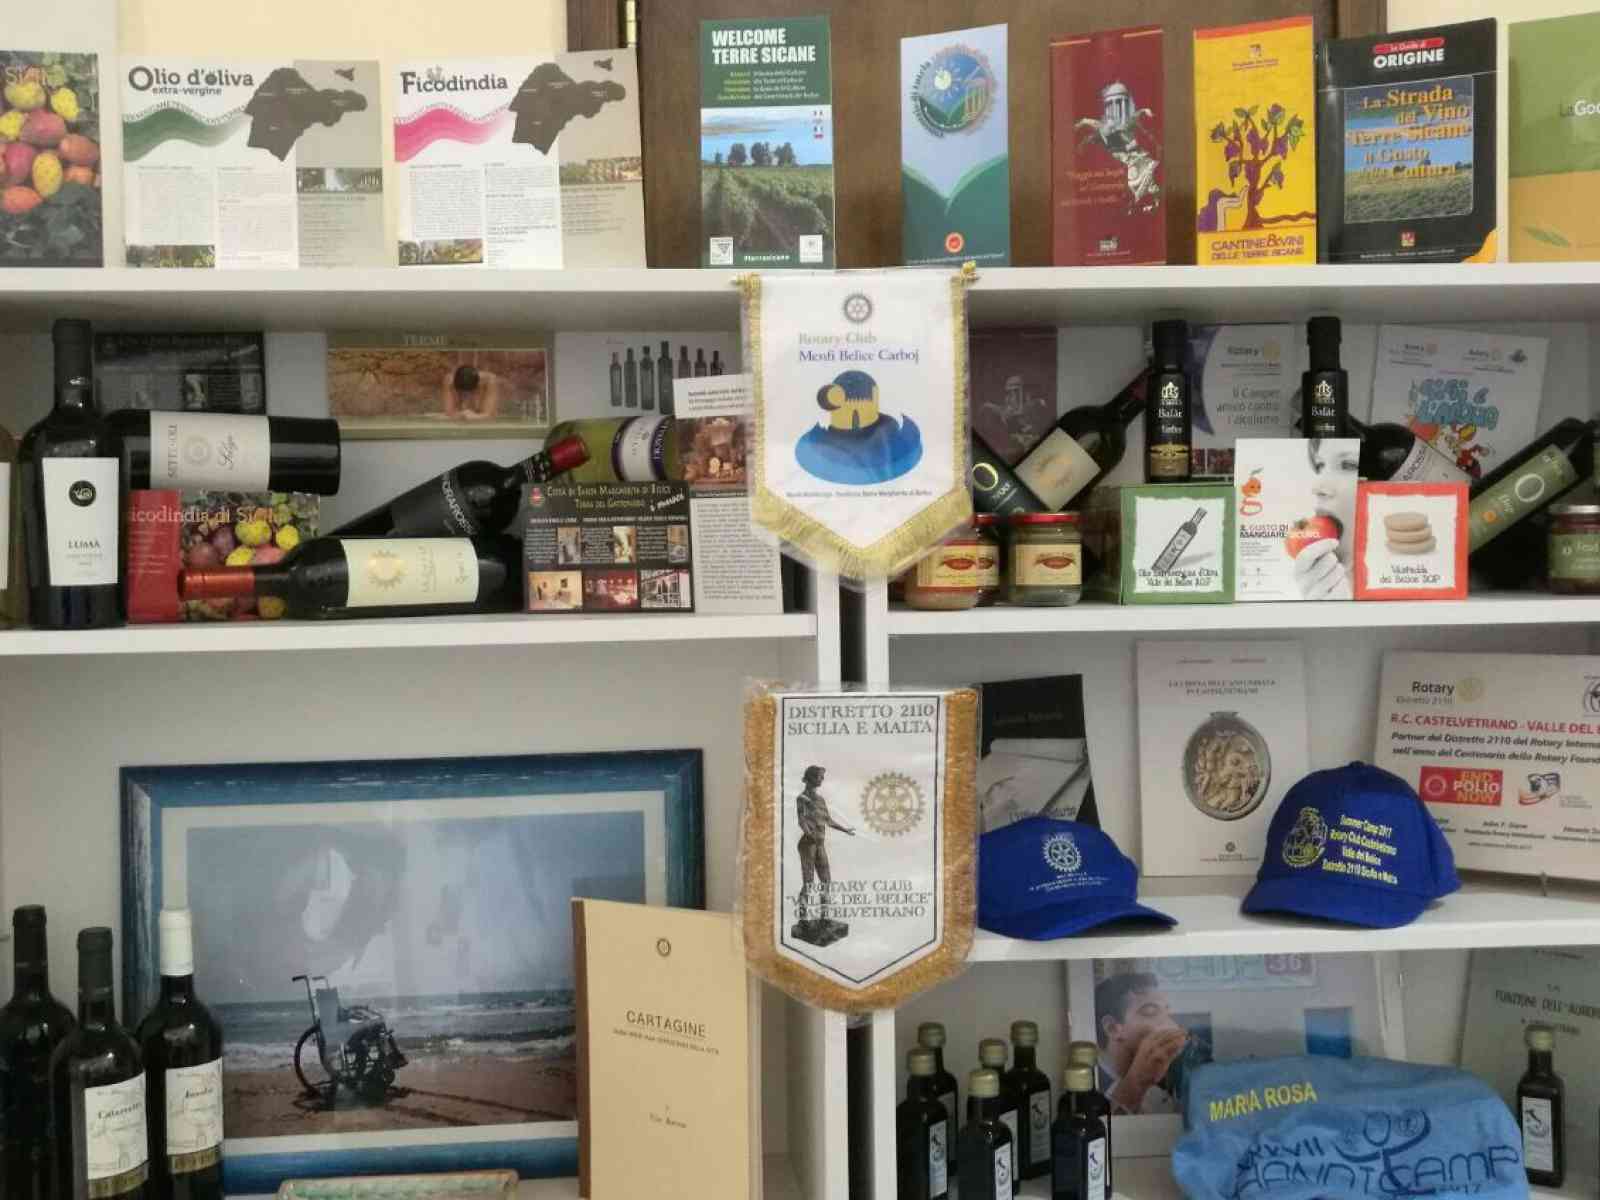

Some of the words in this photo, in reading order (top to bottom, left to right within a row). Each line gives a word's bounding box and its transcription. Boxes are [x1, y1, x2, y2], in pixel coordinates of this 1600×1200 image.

[711, 28, 786, 47] WELCOME
[711, 47, 758, 65] TERRE
[761, 45, 816, 64] SICANE
[1373, 47, 1445, 69] ORIGINE
[128, 65, 181, 91] Olio
[187, 68, 254, 87] d'oliva
[400, 71, 509, 95] Ficodindia
[151, 86, 222, 96] extra-vergine
[1387, 84, 1453, 107] Strada
[1423, 103, 1470, 121] Vino
[846, 331, 878, 344] Club
[799, 349, 835, 361] Menfi
[840, 348, 873, 361] Belice
[131, 504, 210, 524] icodindia
[1412, 681, 1454, 695] Rotary
[789, 704, 894, 720] DISTRETTO
[900, 703, 936, 717] 2110
[787, 721, 851, 736] SICILIA
[856, 721, 868, 735] E
[873, 720, 933, 735] MALTA
[1391, 713, 1412, 725] R.C.
[1415, 714, 1518, 731] CASTELVETRANO
[1527, 721, 1566, 733] VALLE
[1568, 723, 1593, 735] DEL
[1486, 735, 1512, 746] 2110
[1453, 780, 1500, 793] POLIO
[1457, 791, 1497, 803] NOW
[806, 880, 868, 893] ROTARY
[872, 879, 914, 892] CLUB
[841, 893, 871, 905] DEL
[793, 905, 927, 919] CASTELVETRANO
[626, 1010, 706, 1038] CARTAGINE
[1209, 1090, 1262, 1121] MARIA
[1264, 1082, 1318, 1107] ROSA
